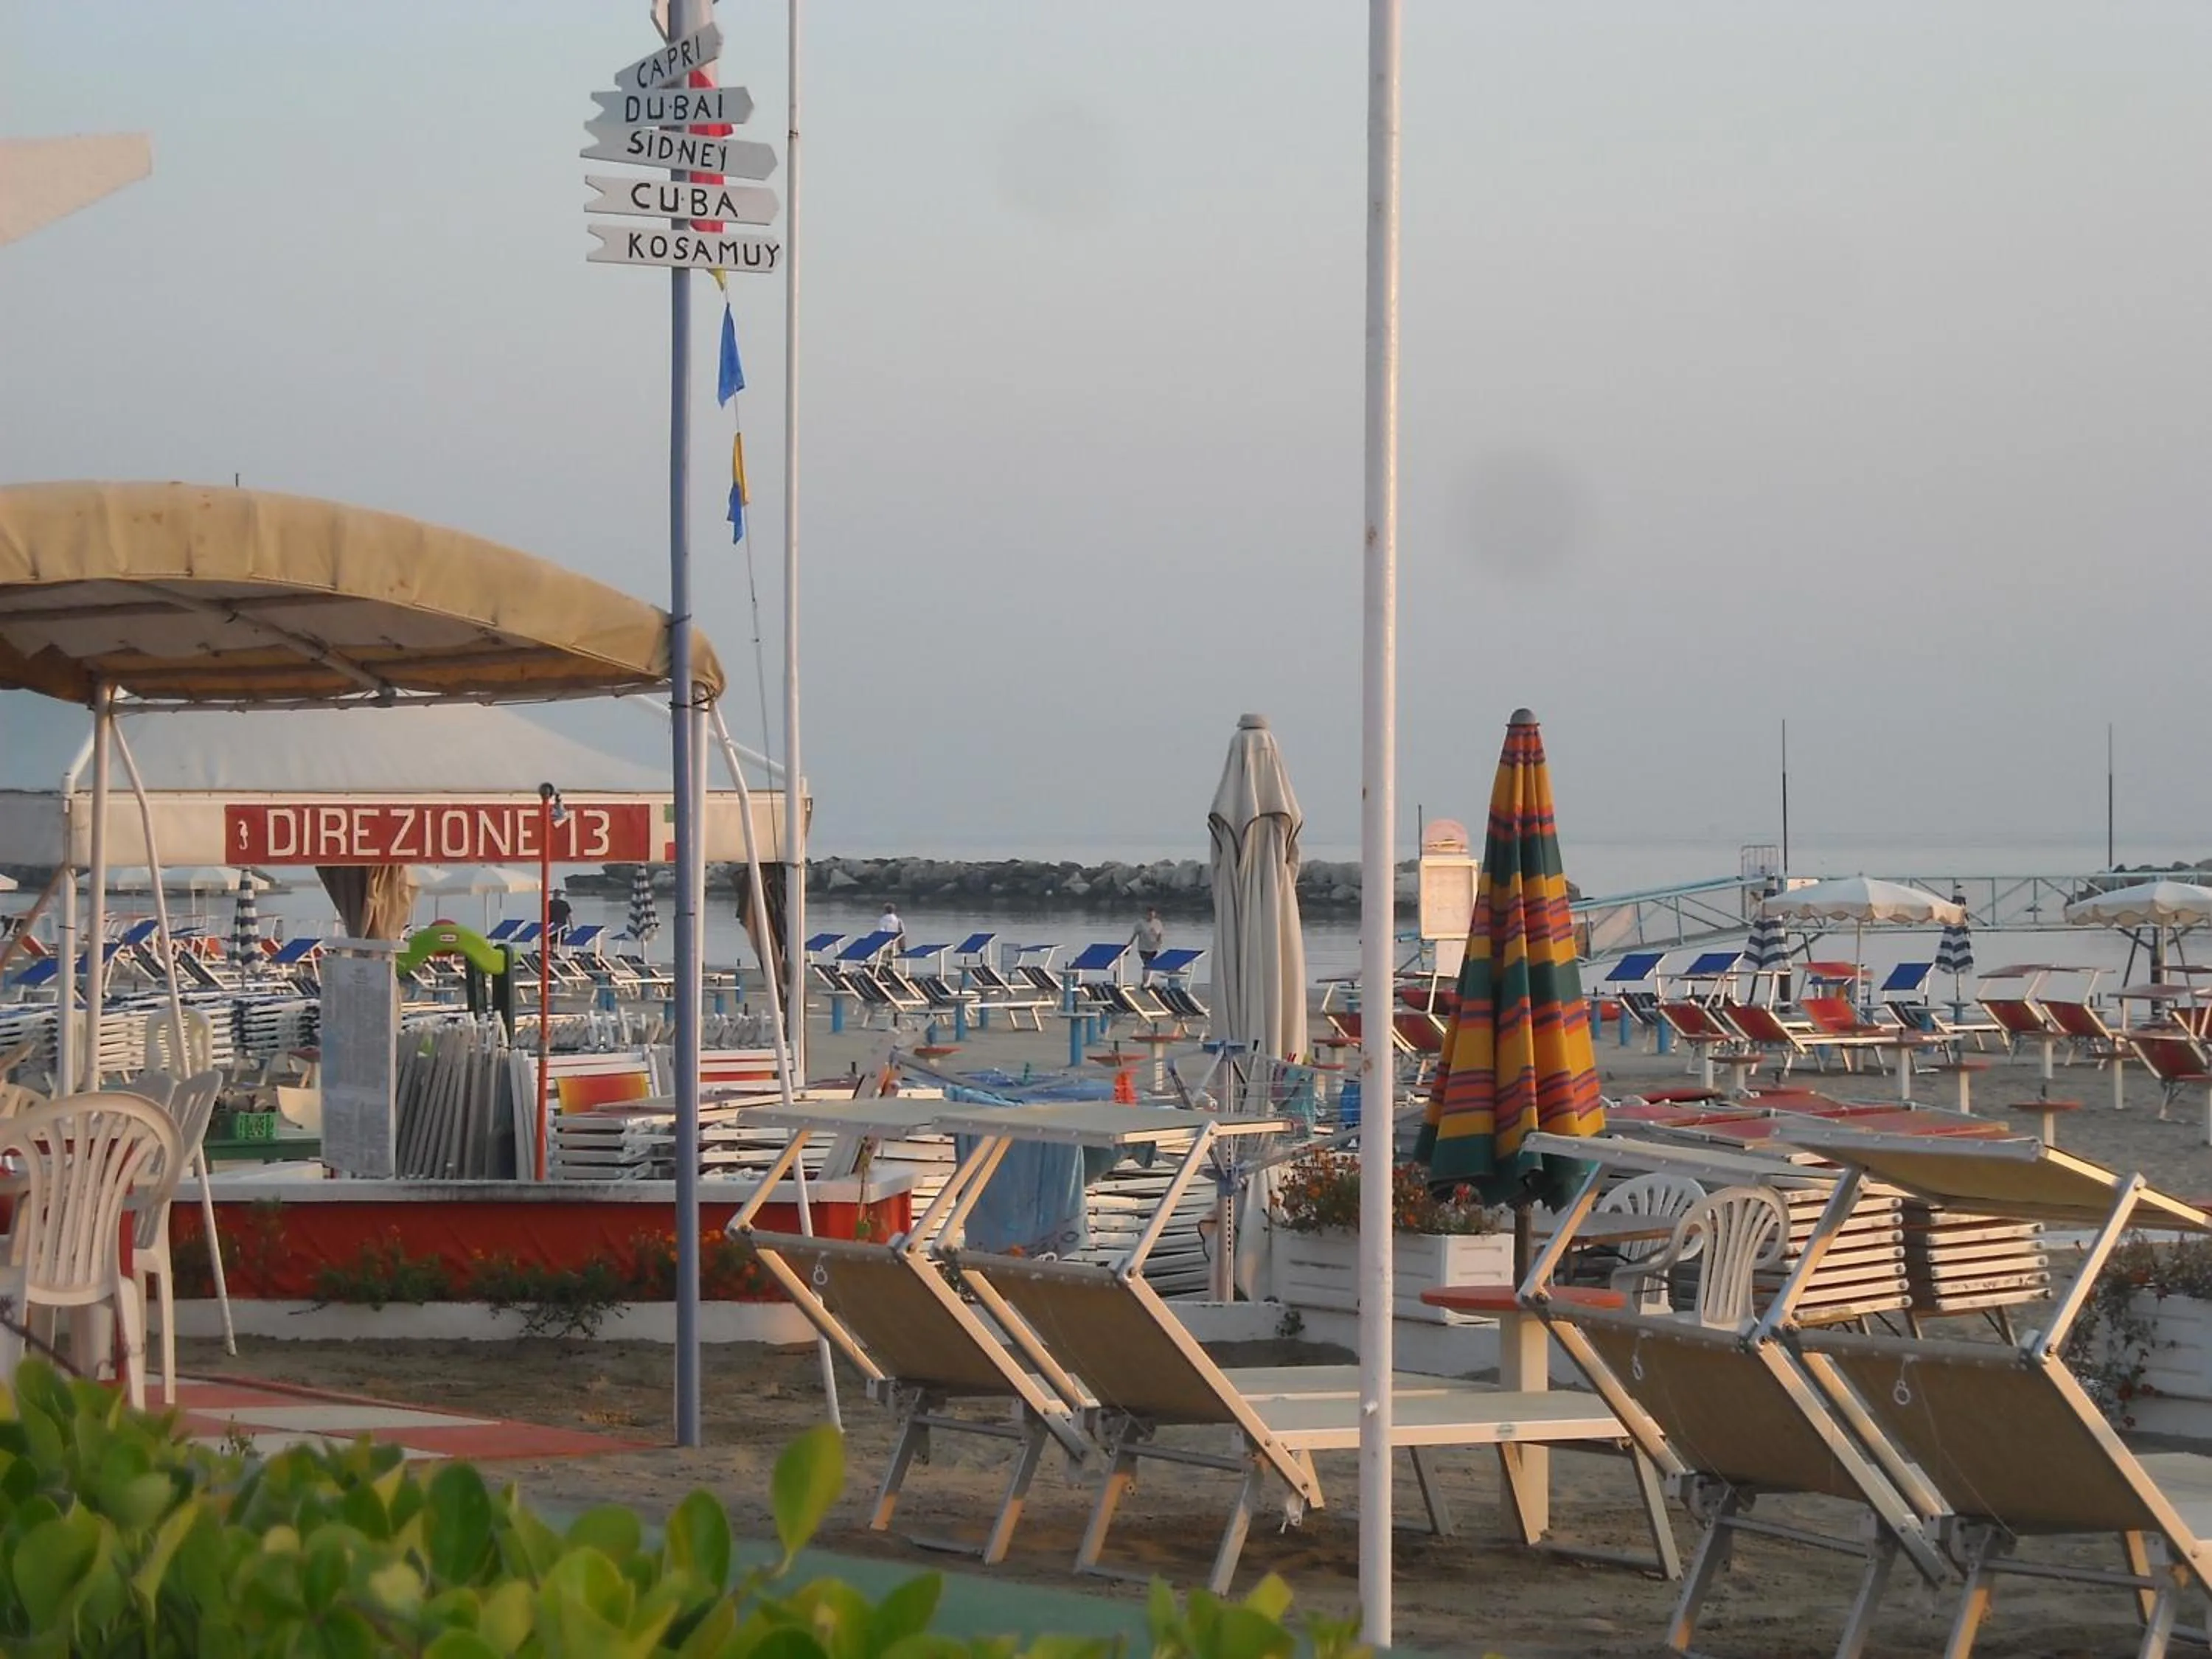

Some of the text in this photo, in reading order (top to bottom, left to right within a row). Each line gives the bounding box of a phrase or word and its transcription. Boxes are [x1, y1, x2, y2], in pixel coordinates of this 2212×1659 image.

[636, 35, 700, 88] CAPRI
[630, 182, 739, 218] CUBA
[266, 808, 611, 858] DIREZIONE 13
